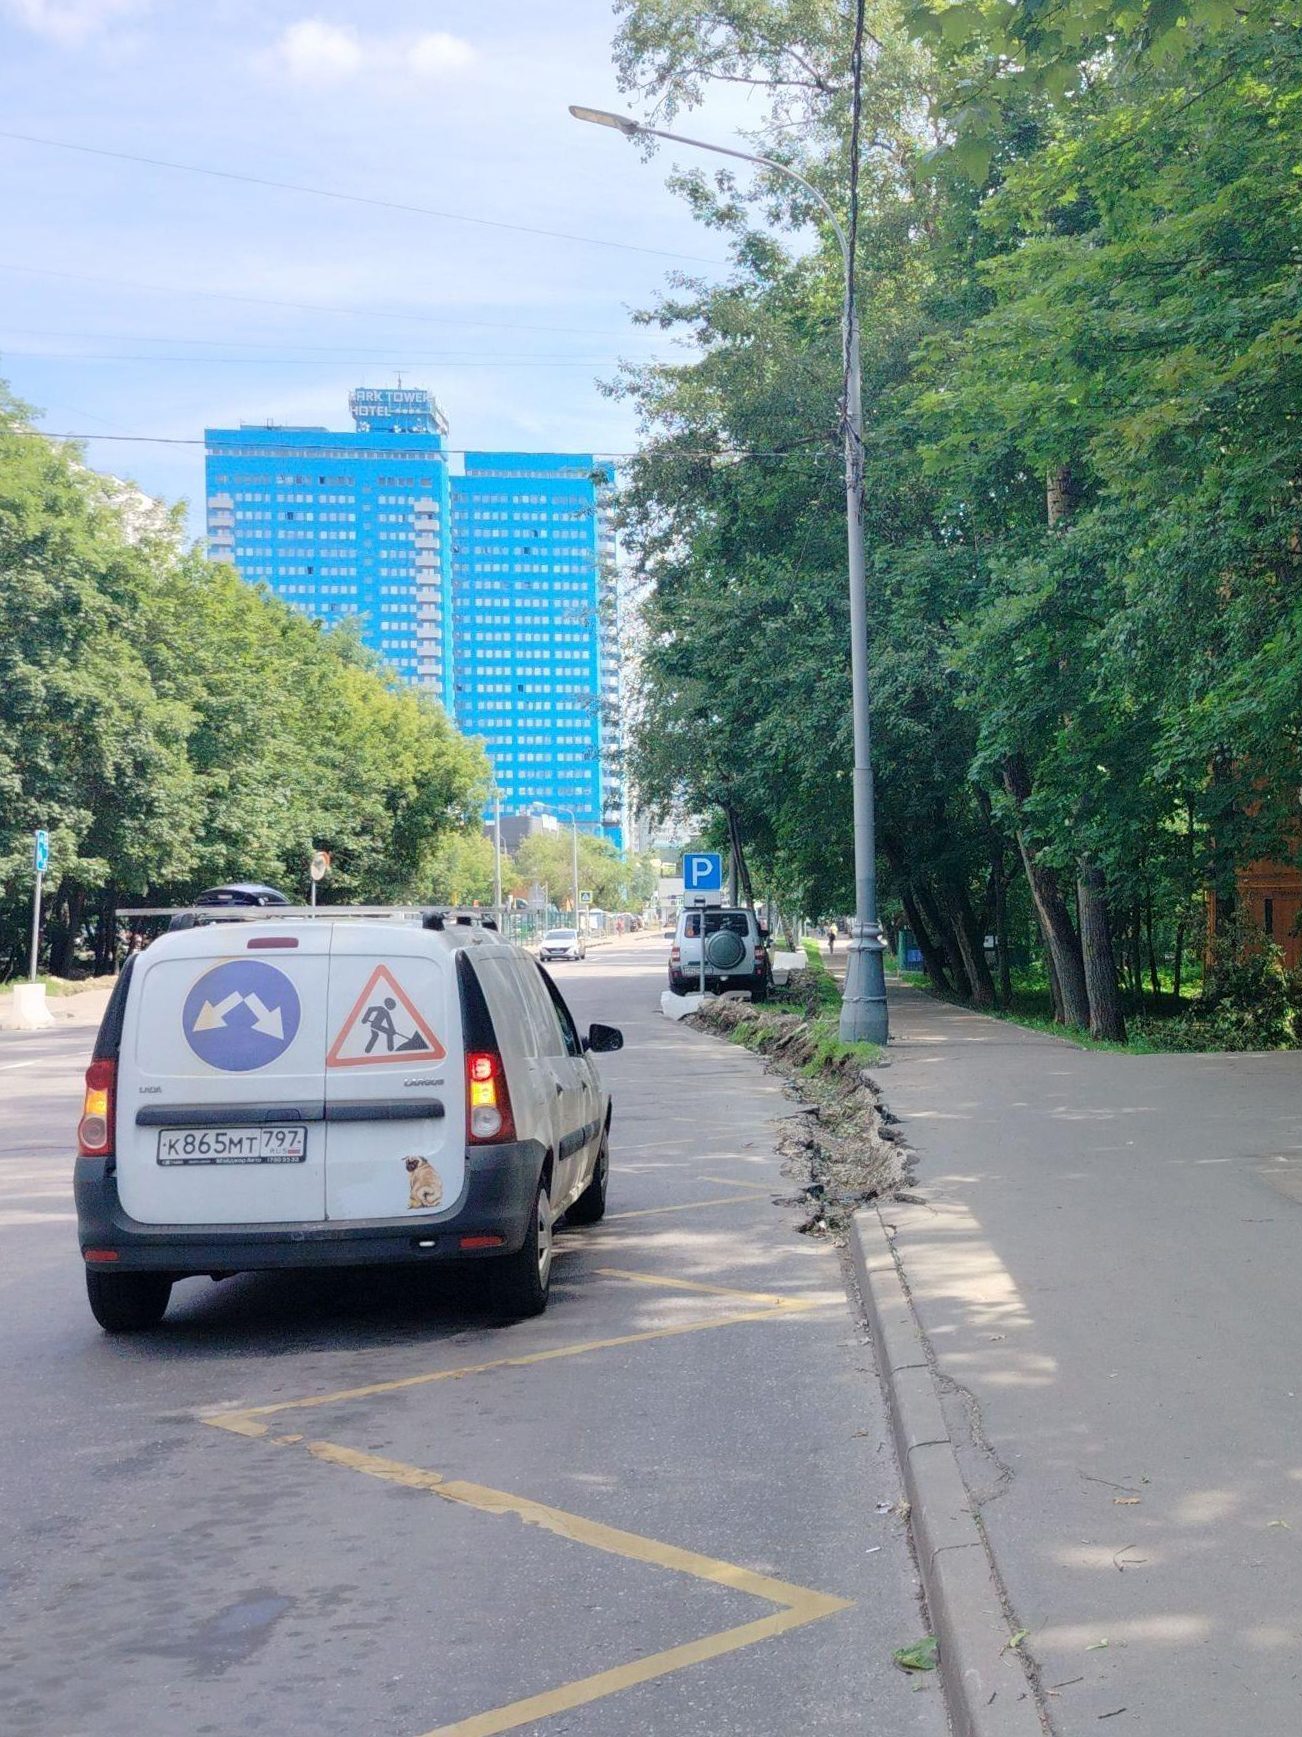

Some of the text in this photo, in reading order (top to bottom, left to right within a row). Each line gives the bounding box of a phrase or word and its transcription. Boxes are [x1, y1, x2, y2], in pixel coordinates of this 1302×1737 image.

[349, 390, 384, 402] ARK
[350, 405, 391, 417] HOTEL
[691, 857, 714, 887] P
[263, 1130, 299, 1148] 797
